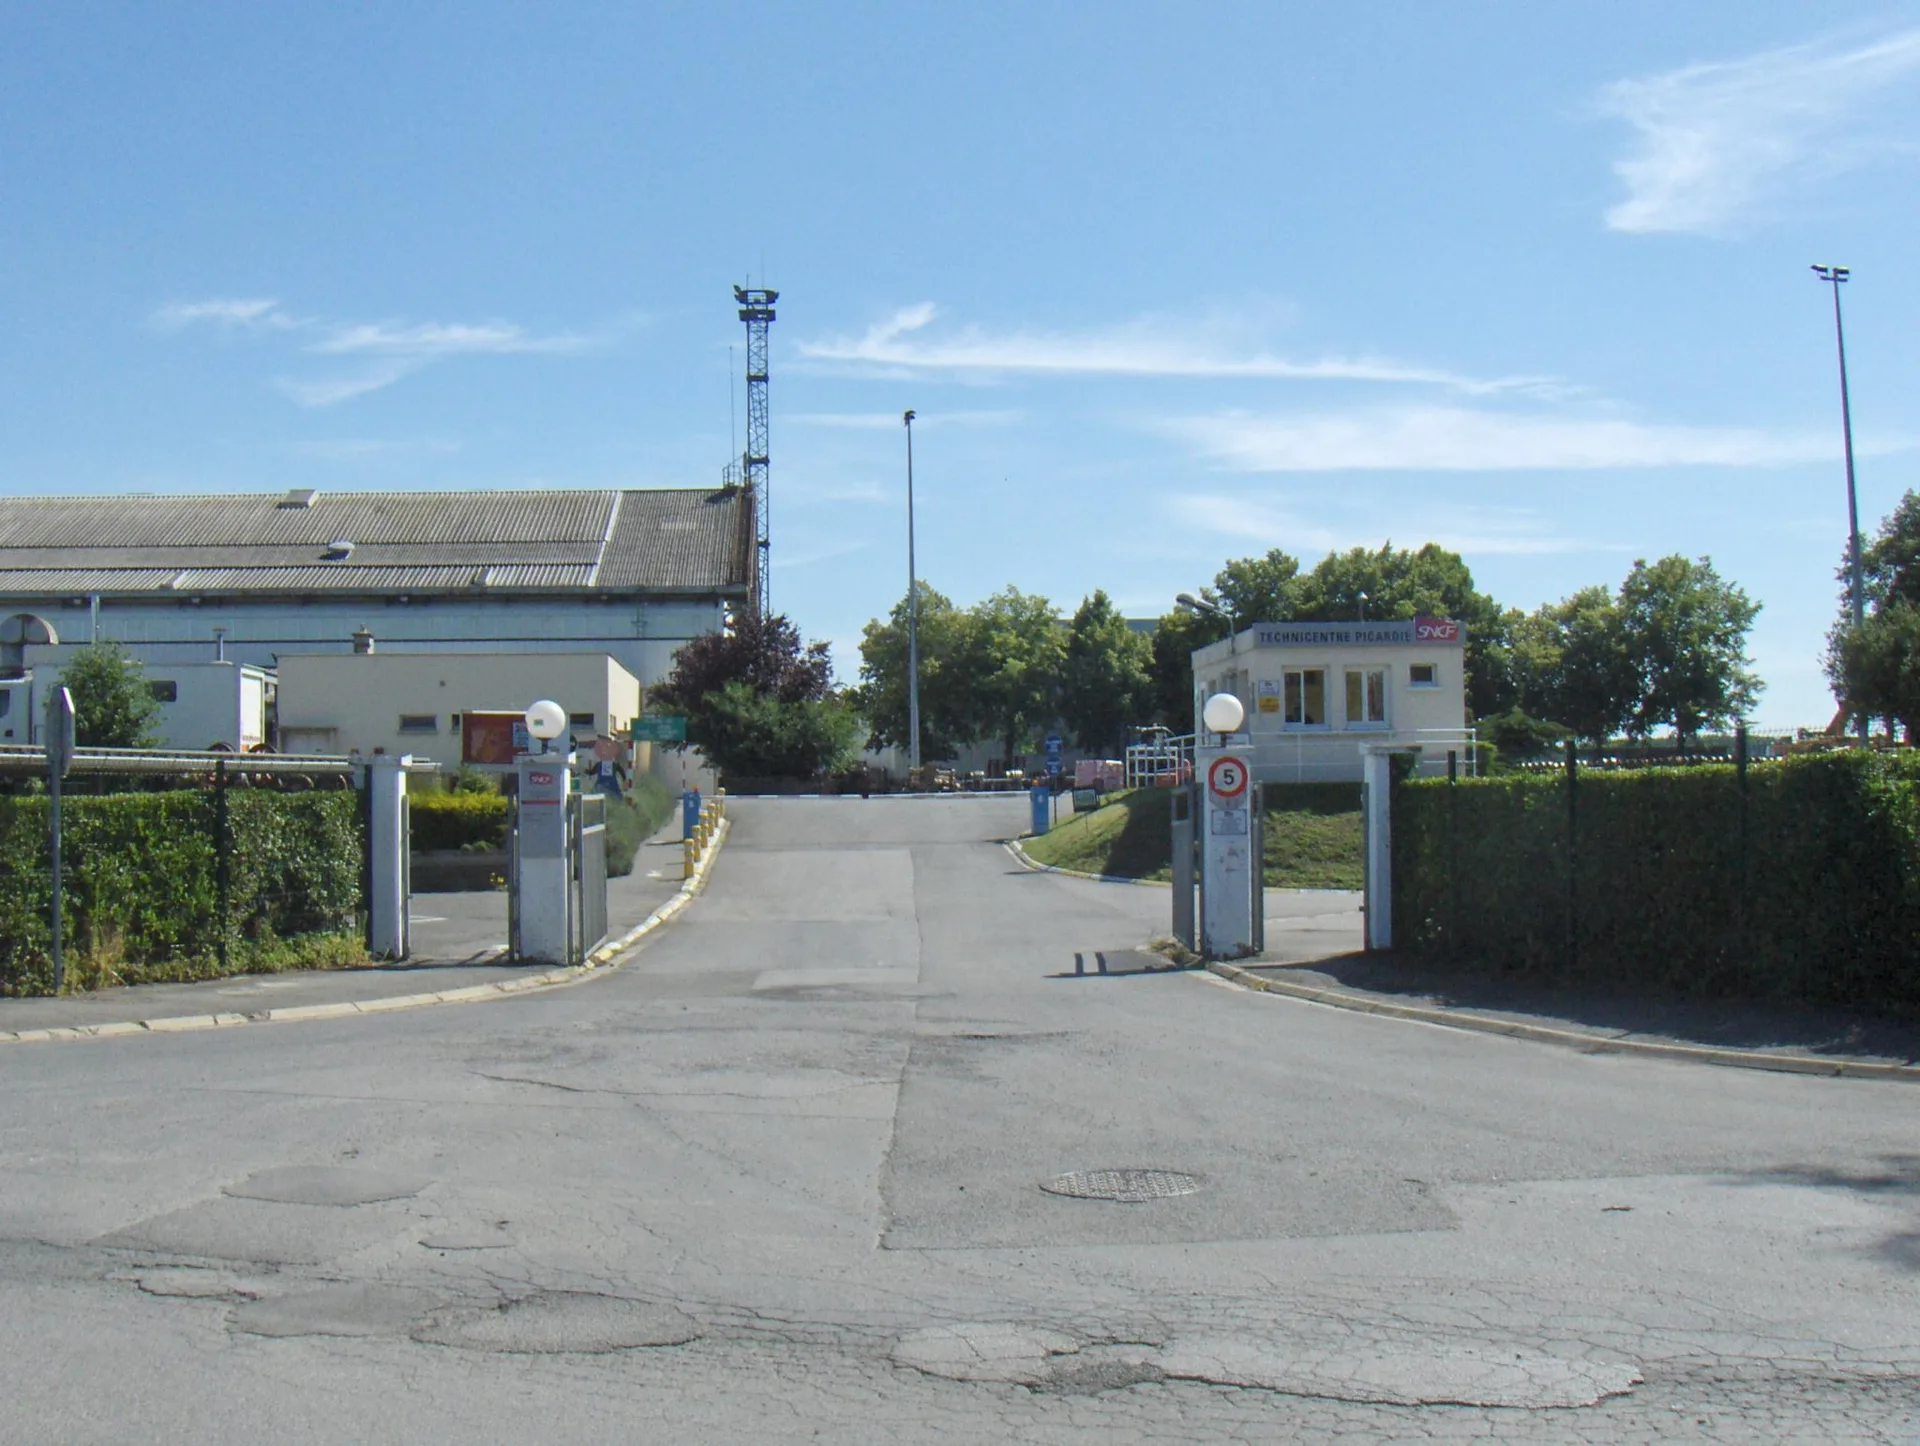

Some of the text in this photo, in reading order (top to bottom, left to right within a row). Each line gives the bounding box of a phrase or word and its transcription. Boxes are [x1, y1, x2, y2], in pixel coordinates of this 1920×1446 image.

[1260, 630, 1411, 643] TECHNICENTRE PICARDIE
[1417, 625, 1457, 639] SNCF
[1223, 769, 1235, 785] 5
